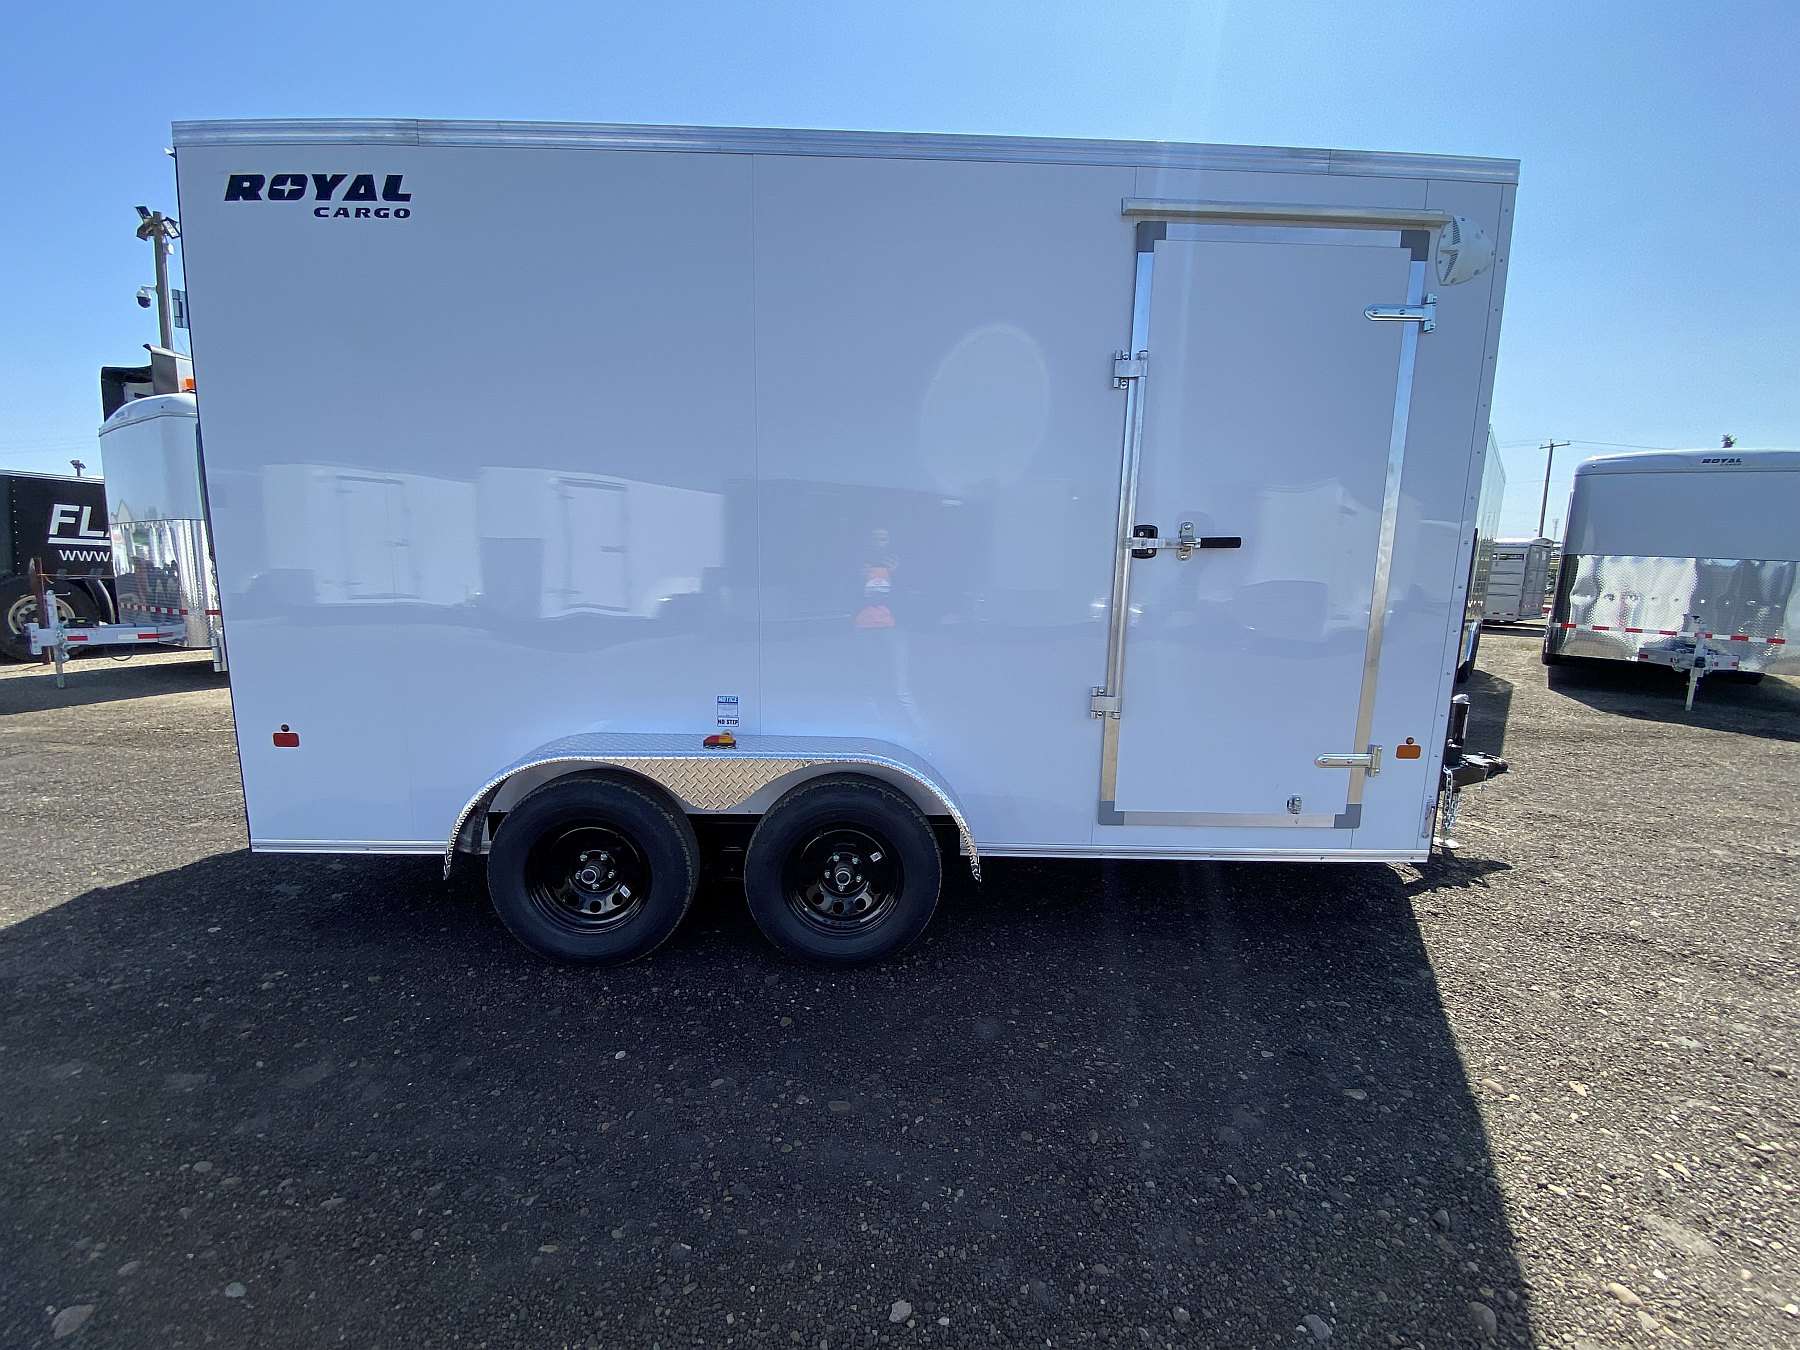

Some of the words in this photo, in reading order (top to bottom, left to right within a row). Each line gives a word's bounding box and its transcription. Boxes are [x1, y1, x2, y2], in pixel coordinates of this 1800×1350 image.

[224, 174, 412, 202] ROYAL
[313, 207, 411, 219] CARGO
[48, 503, 110, 538] FL
